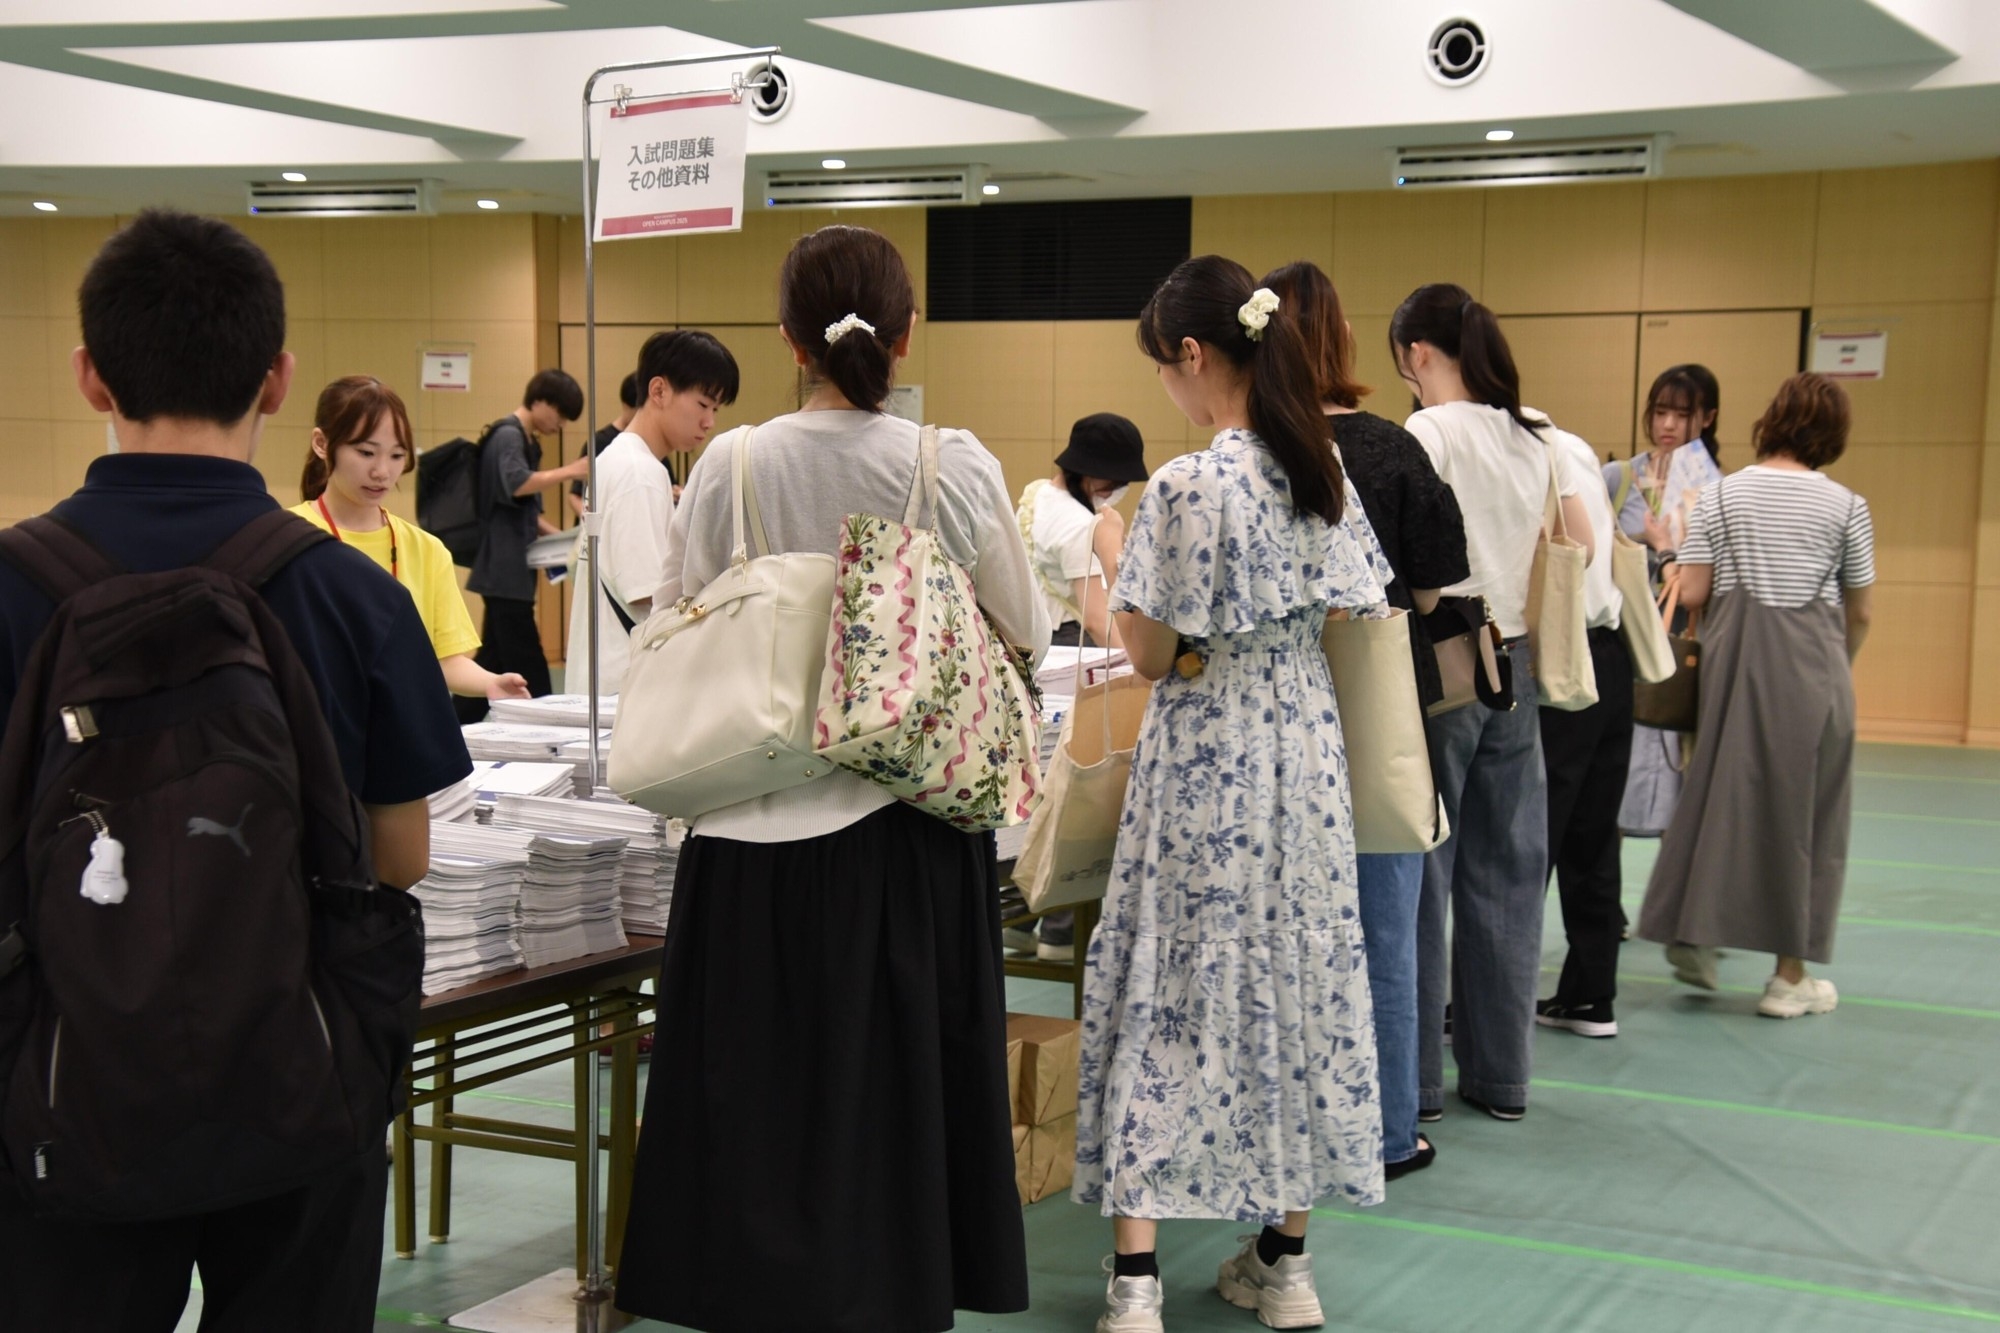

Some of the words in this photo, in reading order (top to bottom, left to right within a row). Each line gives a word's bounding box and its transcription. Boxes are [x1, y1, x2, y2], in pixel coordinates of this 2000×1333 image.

[627, 136, 715, 167] 入試問題集
[628, 163, 710, 191] その他資料
[655, 218, 676, 226] CAMPUS
